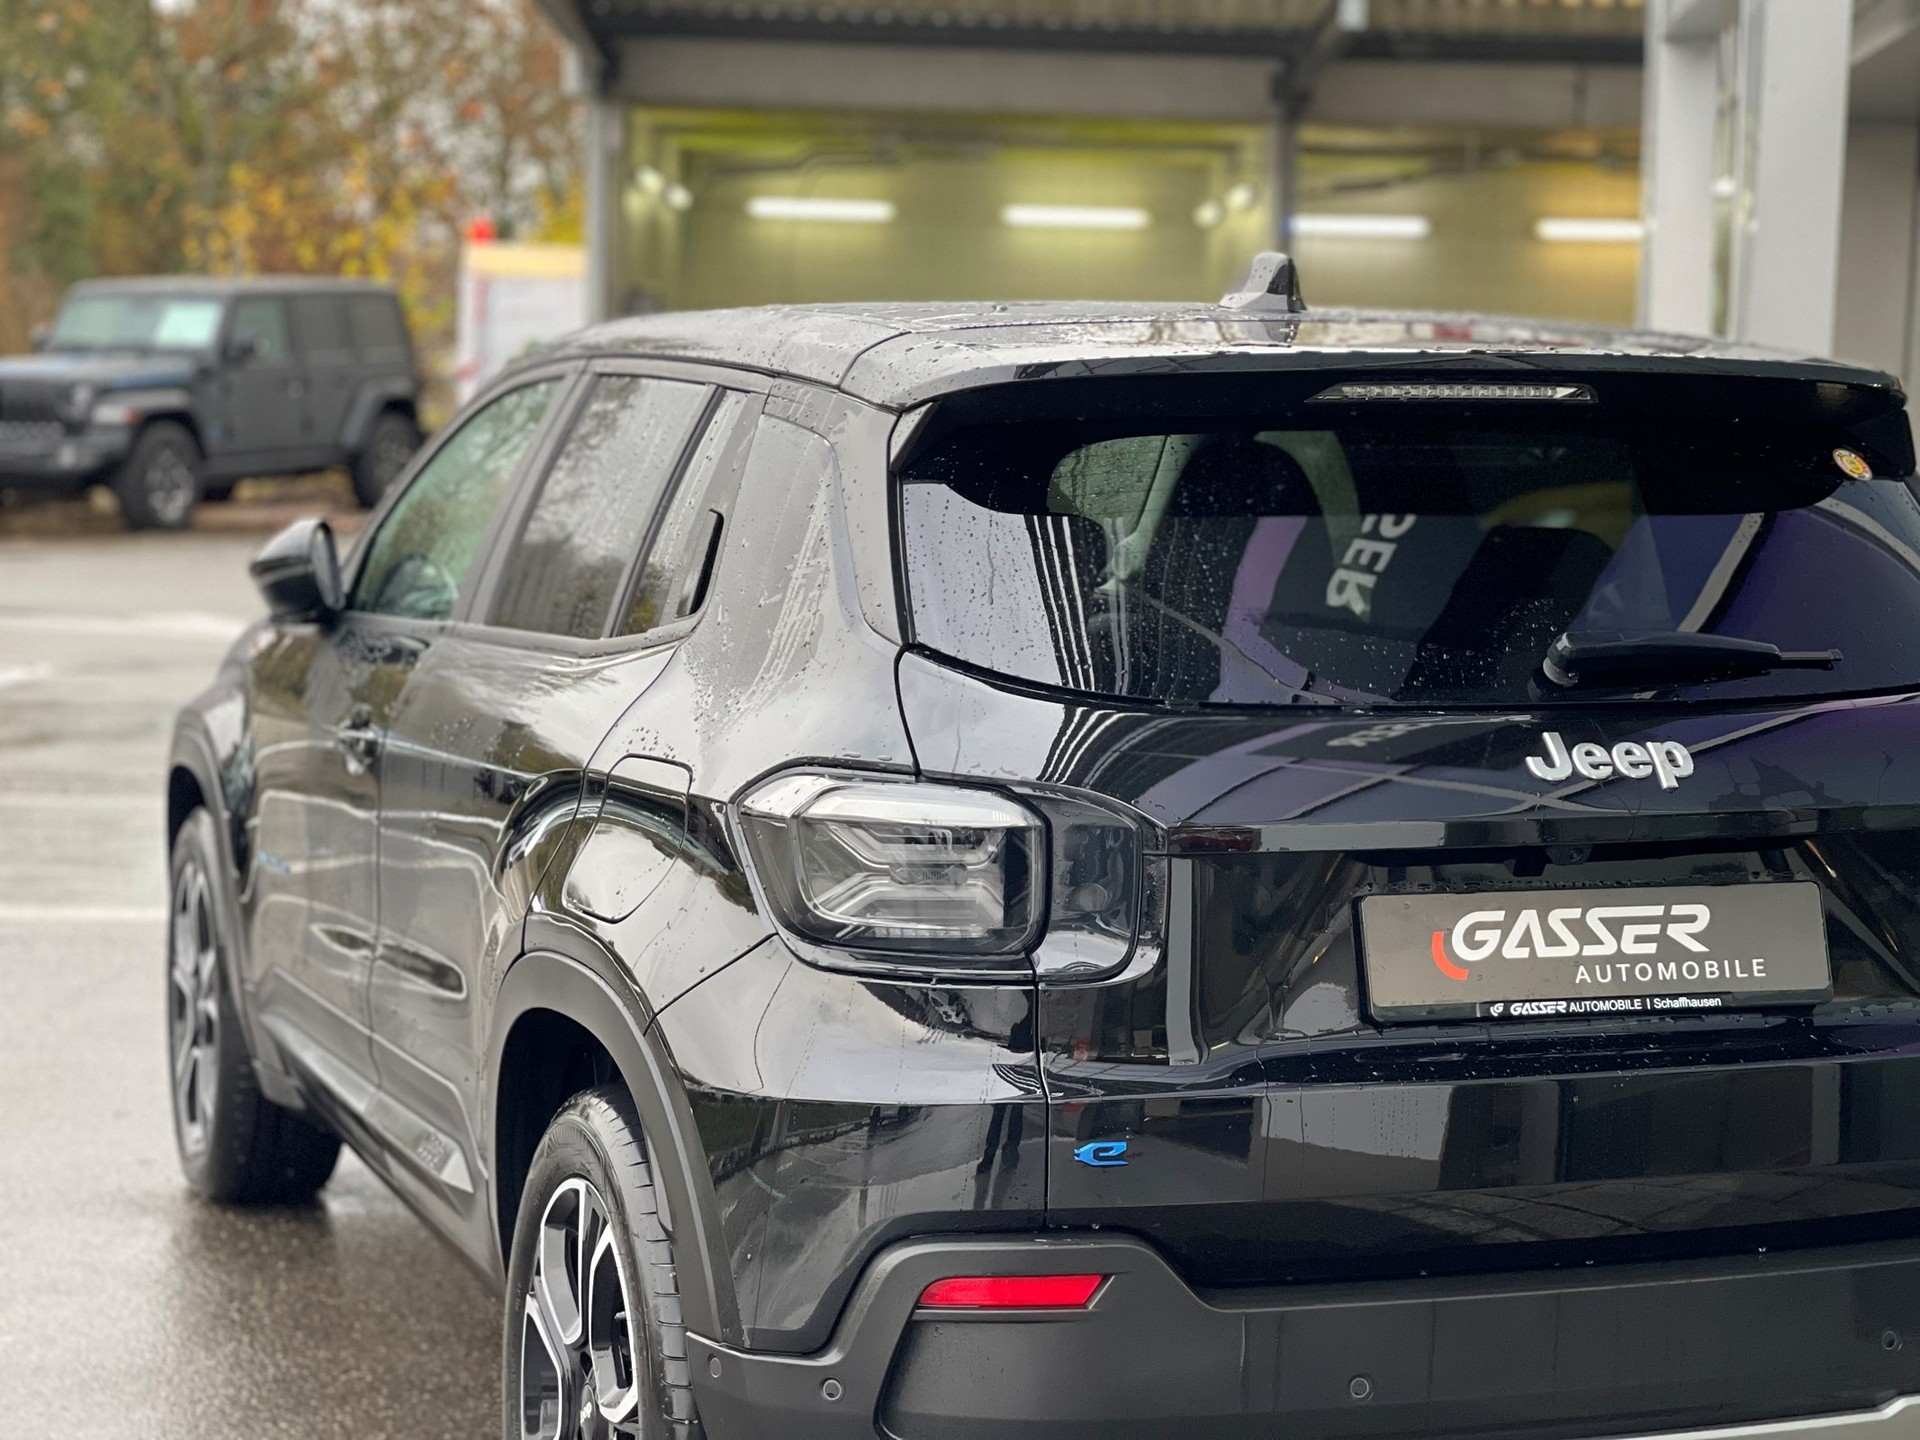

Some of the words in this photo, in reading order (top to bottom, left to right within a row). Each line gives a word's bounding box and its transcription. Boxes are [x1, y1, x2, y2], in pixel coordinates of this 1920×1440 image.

[1525, 732, 1694, 790] Jeep
[1452, 904, 1710, 961] GASSER
[1575, 959, 1766, 983] AUTOMOBILE
[1509, 1002, 1567, 1015] GASSER
[1569, 999, 1642, 1013] AUTOMOBILE
[1653, 997, 1722, 1009] Schaffhausen
